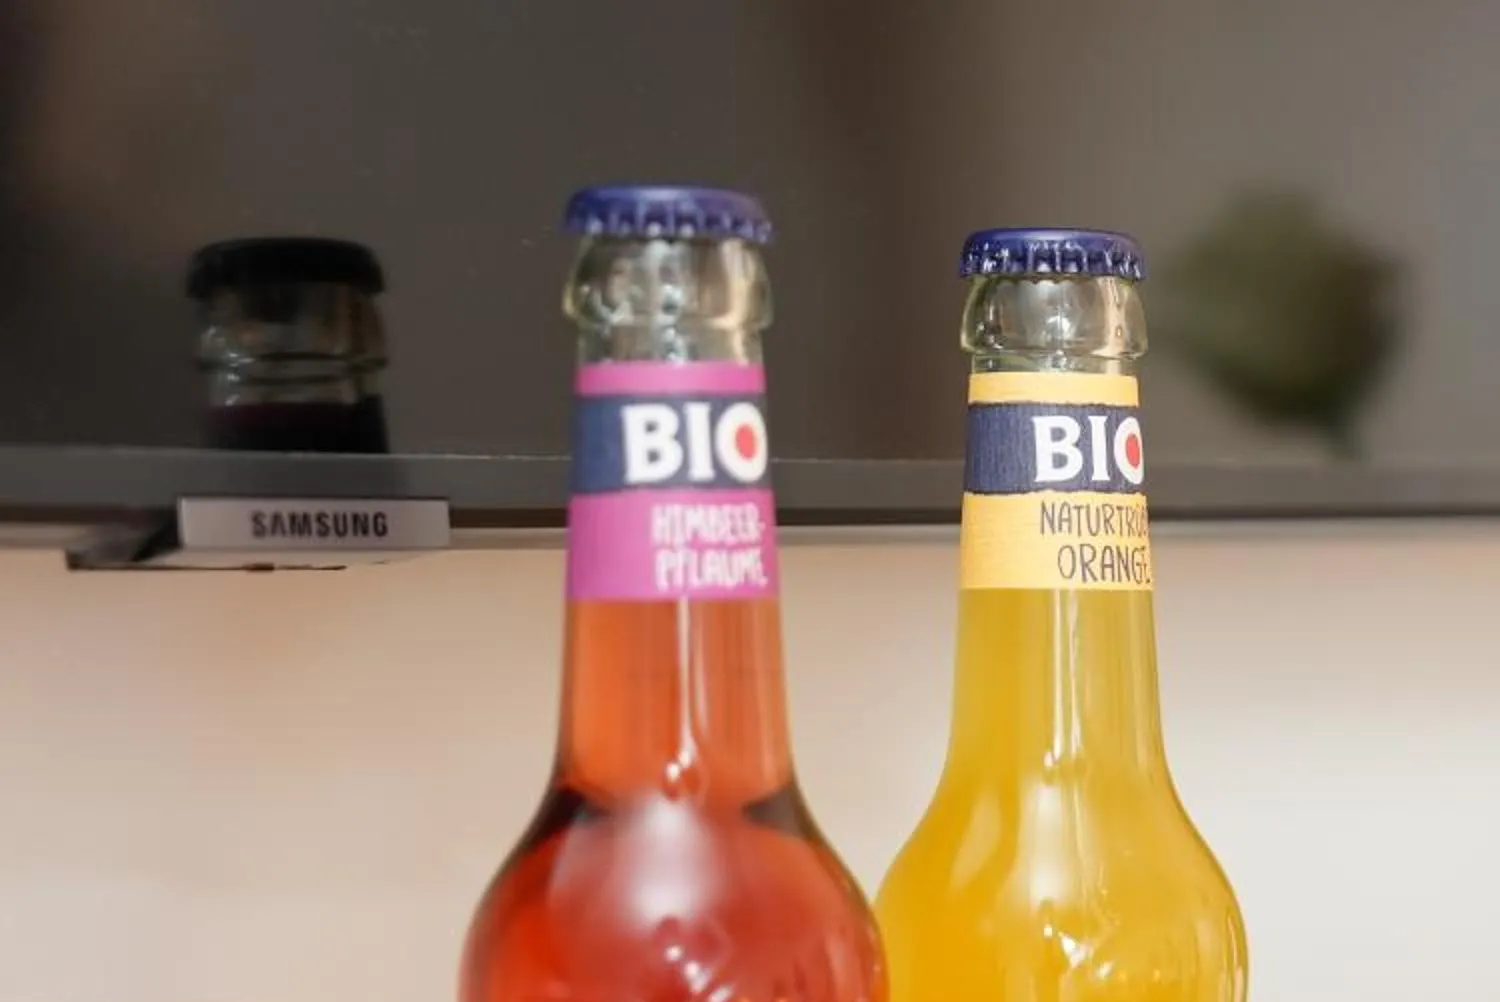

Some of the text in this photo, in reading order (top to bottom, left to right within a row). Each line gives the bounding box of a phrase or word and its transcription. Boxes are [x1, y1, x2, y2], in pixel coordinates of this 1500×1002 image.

[621, 402, 768, 484] BIO
[1032, 415, 1145, 485] BIO
[252, 512, 389, 538] SAMSUNG
